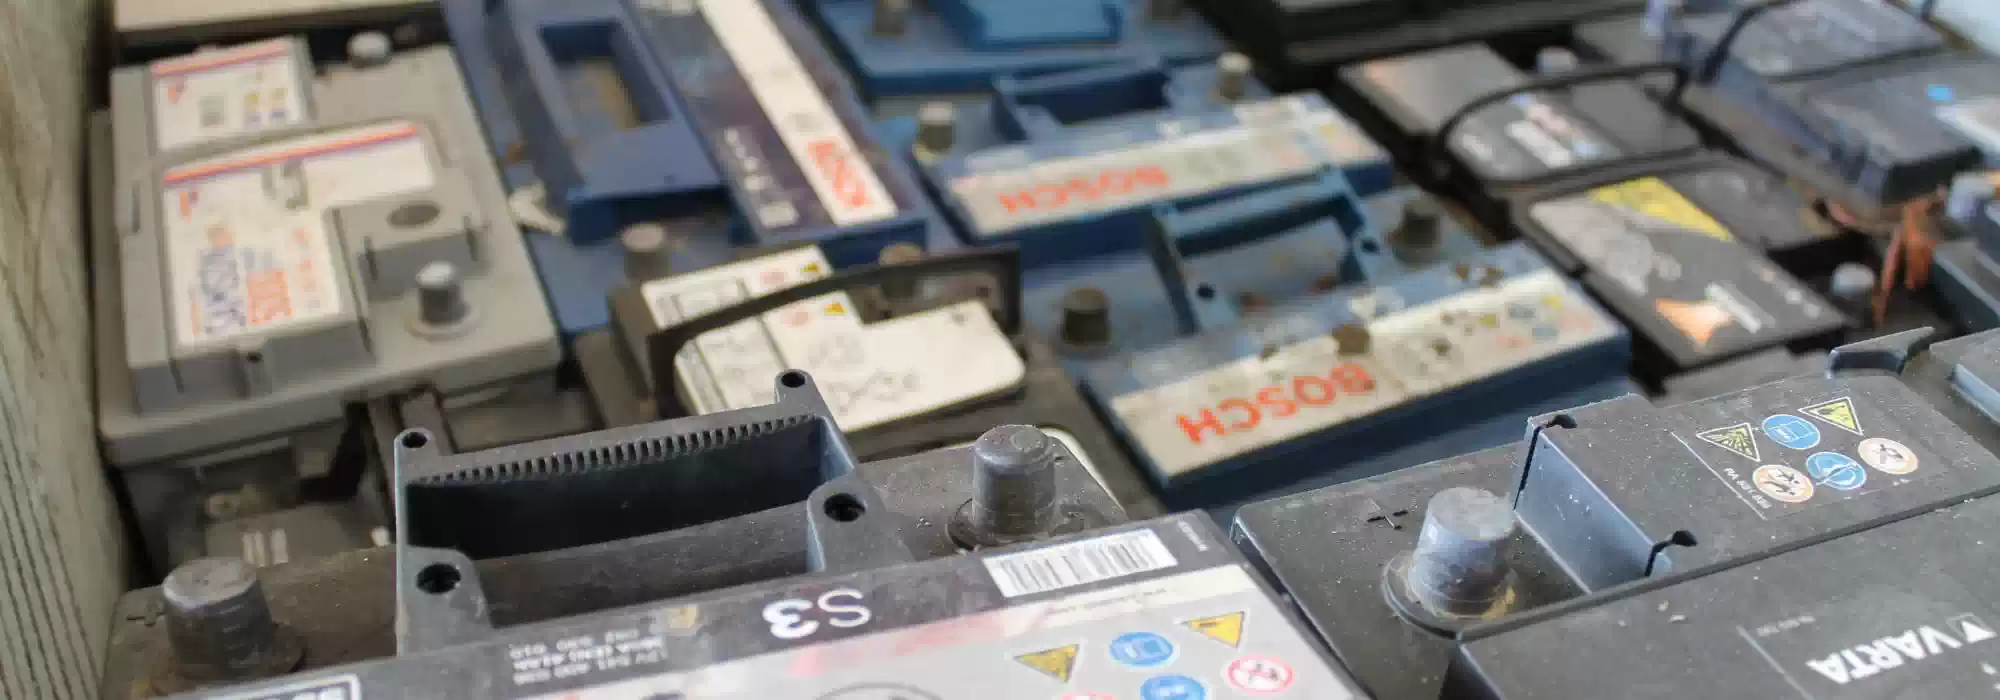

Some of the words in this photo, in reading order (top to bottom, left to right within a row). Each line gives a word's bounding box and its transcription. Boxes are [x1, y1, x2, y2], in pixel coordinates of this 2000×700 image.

[998, 164, 1170, 215] BOSCH
[1174, 360, 1378, 448] BOSCH
[762, 588, 872, 640] S3
[1805, 625, 1962, 685] VARTA
